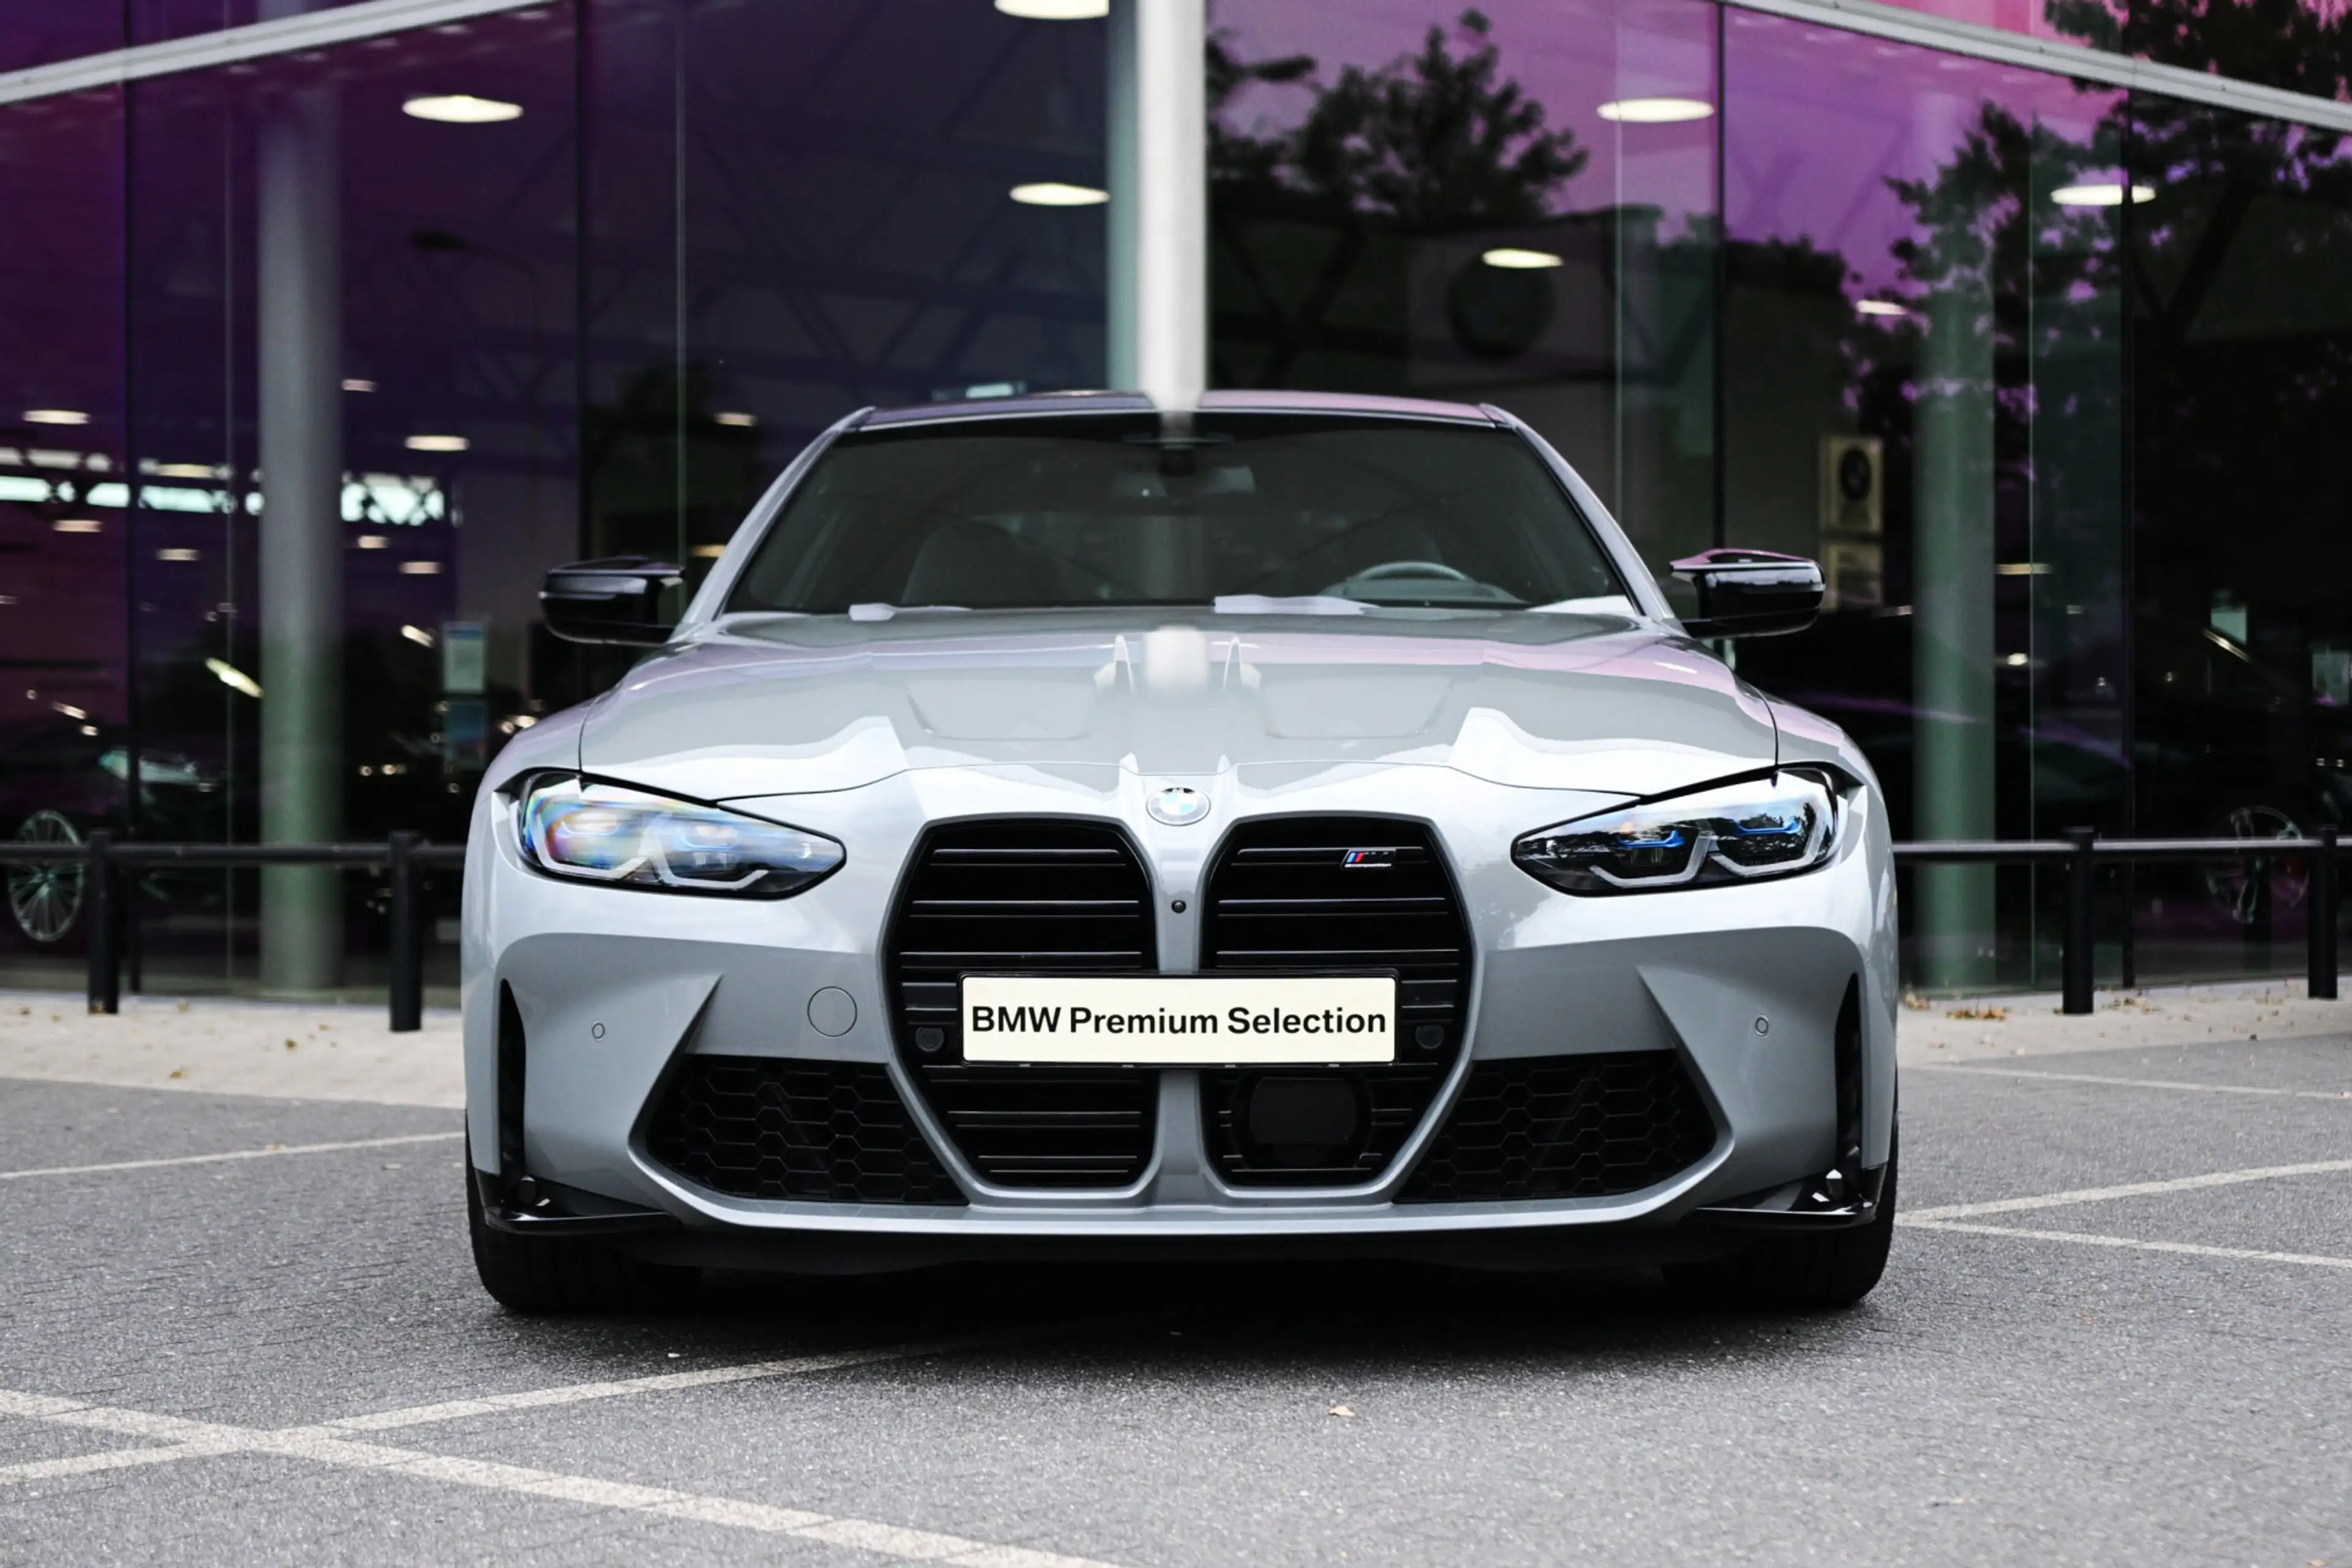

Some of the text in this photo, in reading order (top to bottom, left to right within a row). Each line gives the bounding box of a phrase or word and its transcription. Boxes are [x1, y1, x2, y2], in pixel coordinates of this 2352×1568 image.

[973, 1006, 1385, 1033] BMW Premium Selection
